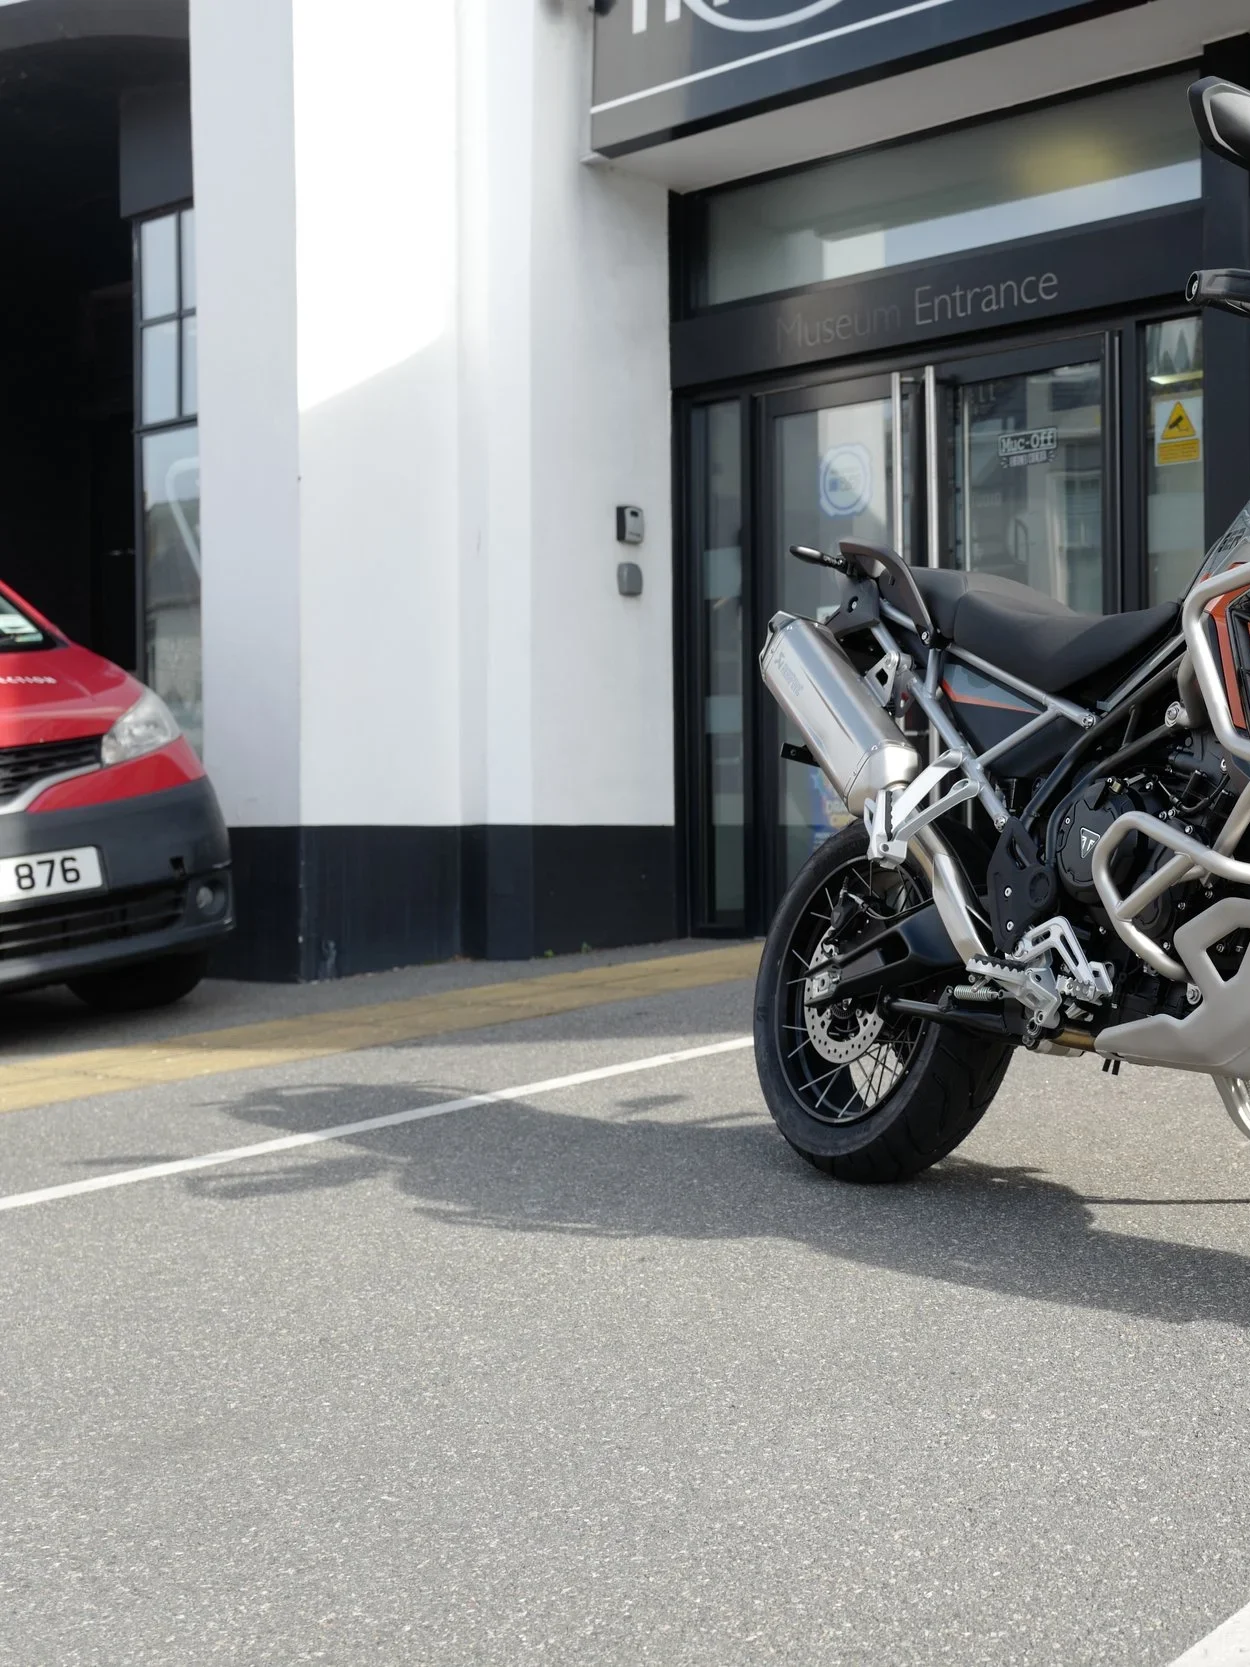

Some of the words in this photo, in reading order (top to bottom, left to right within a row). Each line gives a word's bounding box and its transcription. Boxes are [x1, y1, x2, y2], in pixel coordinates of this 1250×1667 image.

[776, 304, 900, 352] Museum
[914, 272, 1059, 326] Entrance
[1001, 430, 1053, 453] Muc-Off
[15, 857, 81, 890] 876
